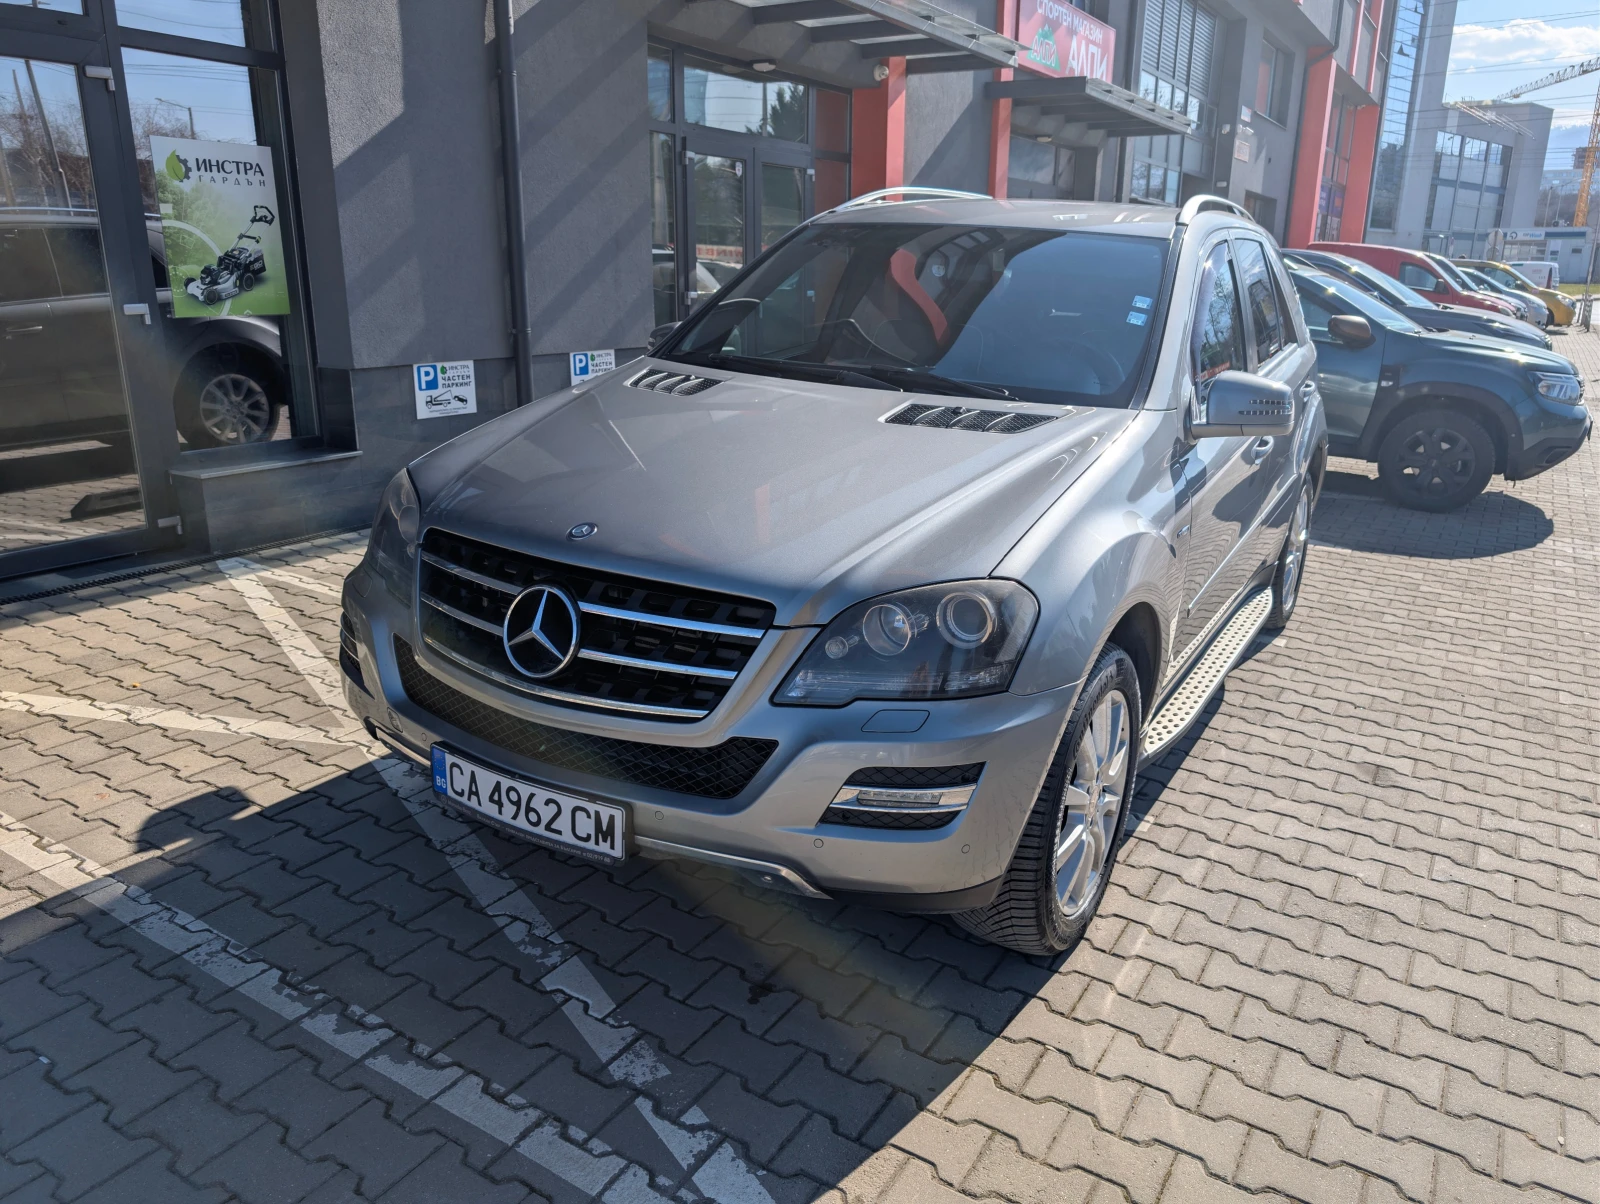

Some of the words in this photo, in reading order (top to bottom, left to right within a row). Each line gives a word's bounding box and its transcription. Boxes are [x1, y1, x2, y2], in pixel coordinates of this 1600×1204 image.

[1037, 0, 1072, 28] СПОРТЕН
[1073, 14, 1103, 44] МАГАЗИН
[1066, 34, 1107, 82] АЛПИ
[196, 158, 264, 177] ИНСТРА
[199, 175, 266, 187] ГАРДЪН
[575, 354, 586, 375] P
[420, 366, 435, 390] P
[442, 374, 471, 382] ЧАСТЕН
[442, 380, 473, 389] ПАРКИНГ
[436, 775, 447, 789] BG
[488, 780, 563, 836] 4962
